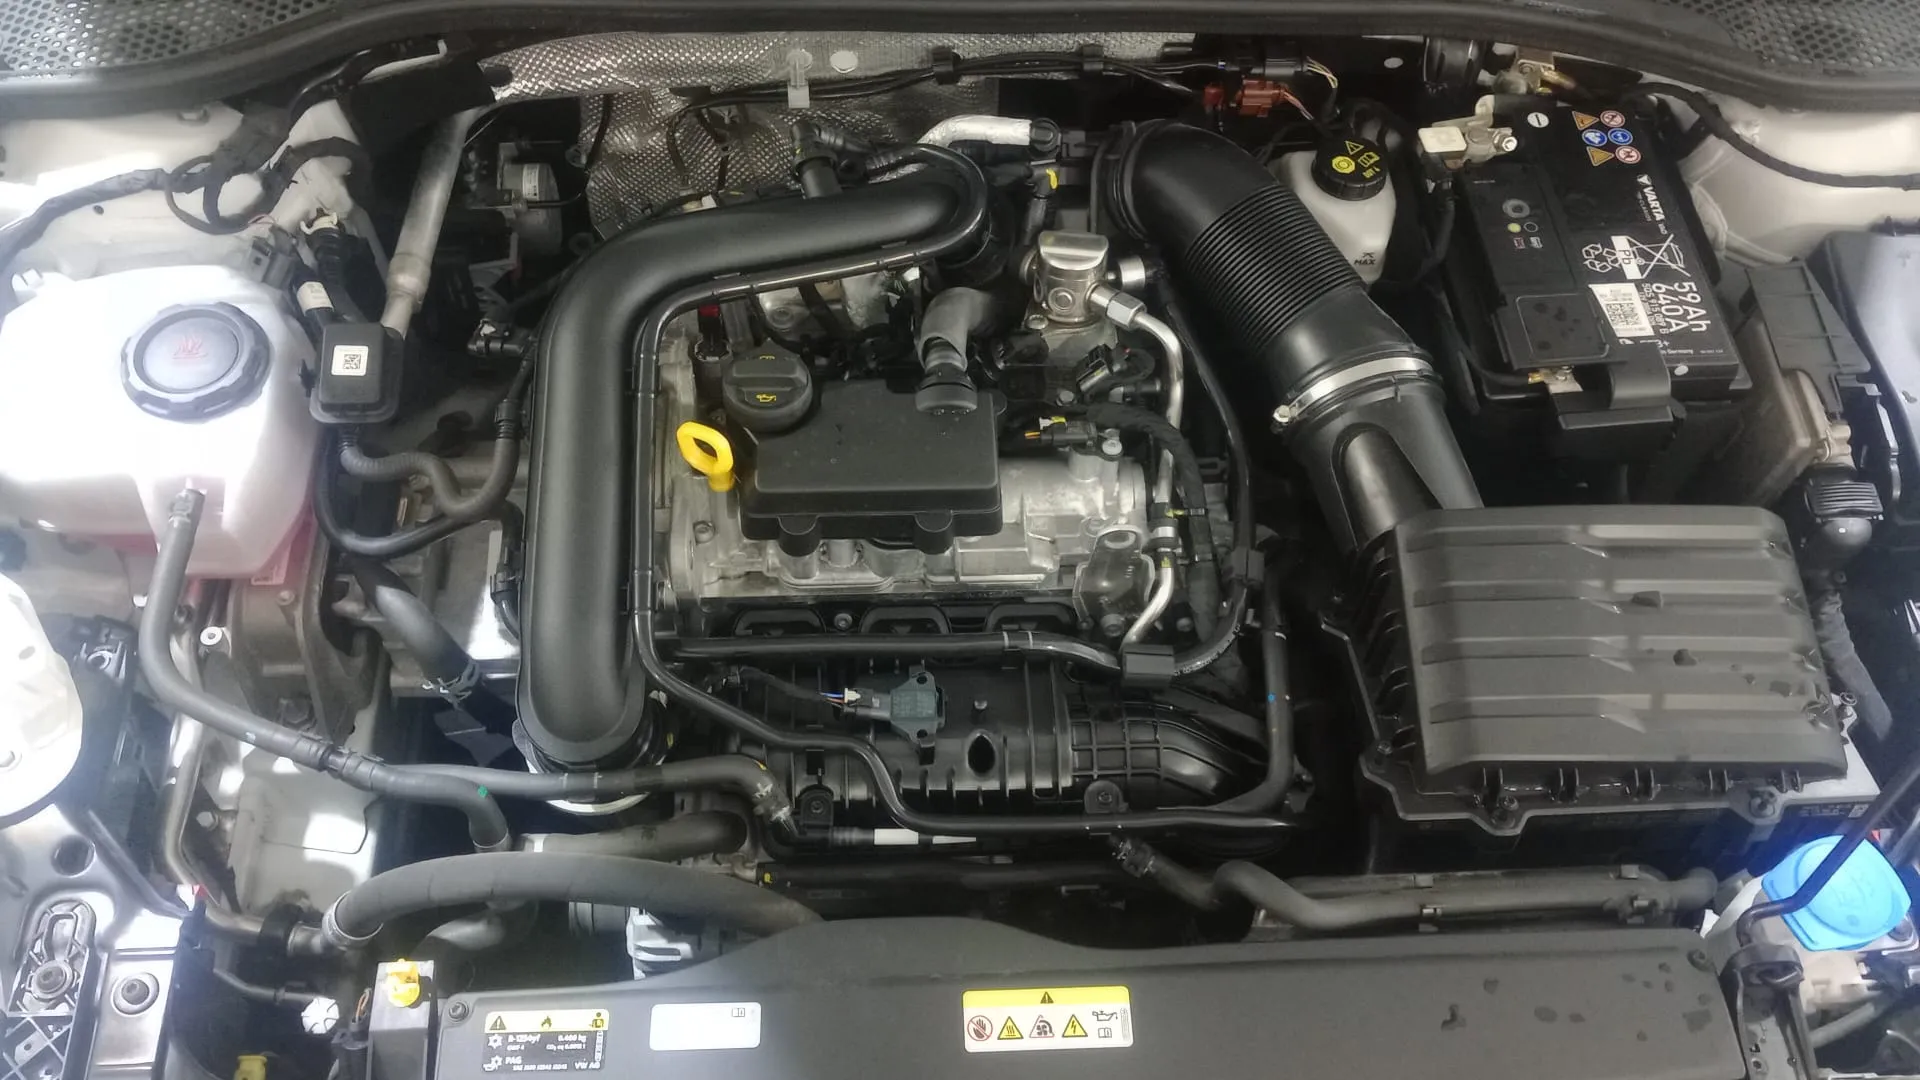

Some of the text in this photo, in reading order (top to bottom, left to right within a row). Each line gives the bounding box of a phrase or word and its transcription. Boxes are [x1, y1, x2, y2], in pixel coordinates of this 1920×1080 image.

[1643, 186, 1665, 221] VARTA
[1621, 249, 1633, 265] Pb
[1652, 282, 1690, 333] 640A
[1673, 281, 1711, 332] 59Ah
[505, 1056, 522, 1064] PAG
[574, 1061, 588, 1070] VW
